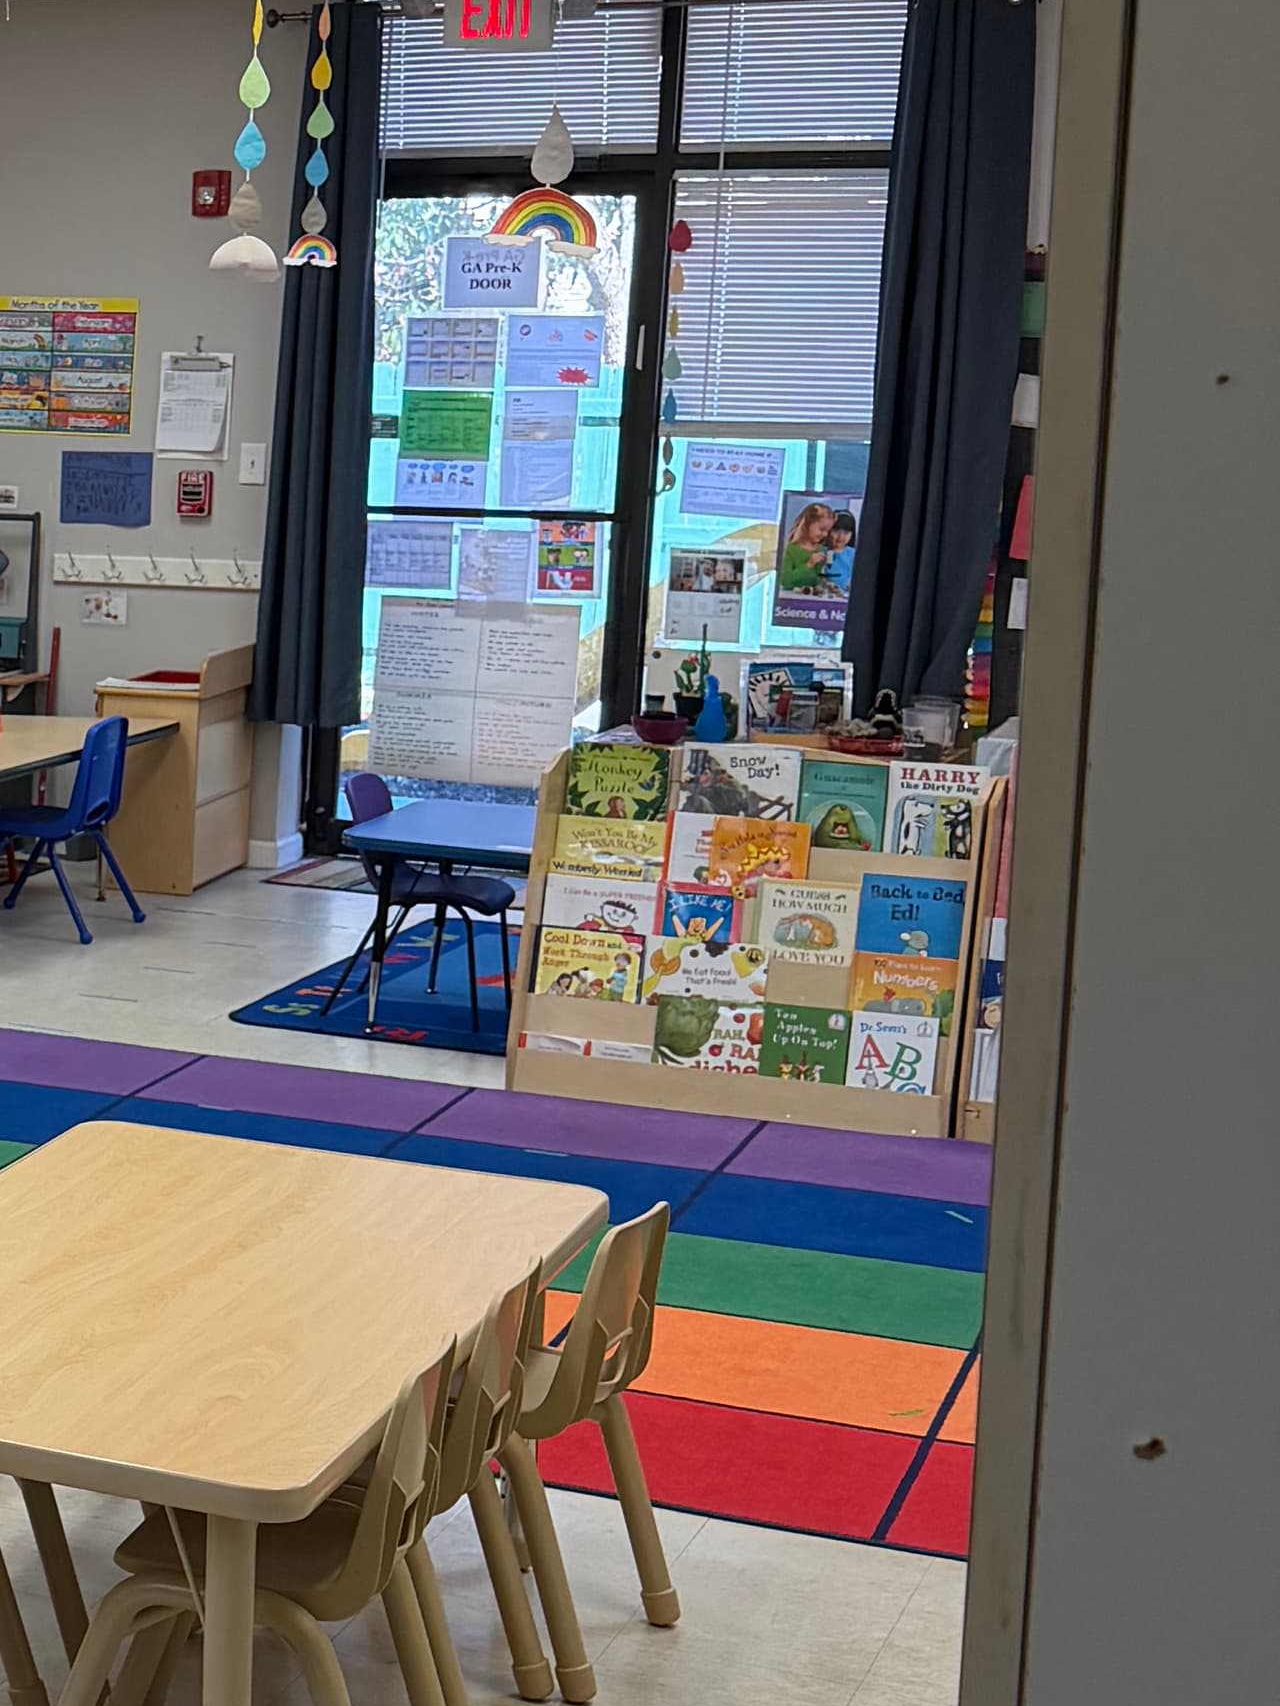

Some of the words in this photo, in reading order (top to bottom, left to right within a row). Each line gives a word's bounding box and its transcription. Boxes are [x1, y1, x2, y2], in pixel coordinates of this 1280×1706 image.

[461, 262, 482, 274] GA
[486, 262, 522, 274] Pre-K
[469, 278, 513, 290] DOOR
[11, 300, 45, 310] Months
[48, 299, 60, 309] of
[62, 300, 77, 309] the
[78, 300, 99, 310] Year
[774, 606, 817, 620] Science
[819, 606, 829, 619] &
[730, 756, 767, 768] Snow
[587, 760, 642, 781] Monkey
[747, 764, 780, 780] Day!
[900, 767, 981, 785] HARRY
[594, 776, 635, 793] Puzzle
[900, 781, 919, 790] the
[922, 783, 952, 794] Dirty
[956, 785, 981, 795] Dog
[572, 828, 602, 839] Won't
[606, 828, 623, 838] You
[627, 830, 638, 839] Be
[641, 833, 658, 846] My
[604, 865, 642, 878] Worried
[791, 889, 831, 901] GUESS
[871, 883, 913, 900] Back
[917, 888, 930, 899] to
[679, 894, 707, 907] LIKE
[711, 898, 732, 913] ME!
[772, 899, 804, 910] HOW
[807, 901, 847, 914] MUCH
[890, 904, 921, 921] Ed!
[544, 932, 569, 944] Cool
[573, 935, 605, 948] Down
[773, 950, 811, 963] LOVE
[814, 953, 845, 966] YOU
[694, 968, 708, 976] Eat
[711, 968, 731, 977] Food
[685, 976, 710, 985] That's
[873, 971, 939, 991] Numbers
[775, 1009, 798, 1020] Ten
[777, 1021, 817, 1035] Apples
[773, 1034, 789, 1046] Up
[791, 1036, 808, 1047] On
[813, 1037, 838, 1050] Top!
